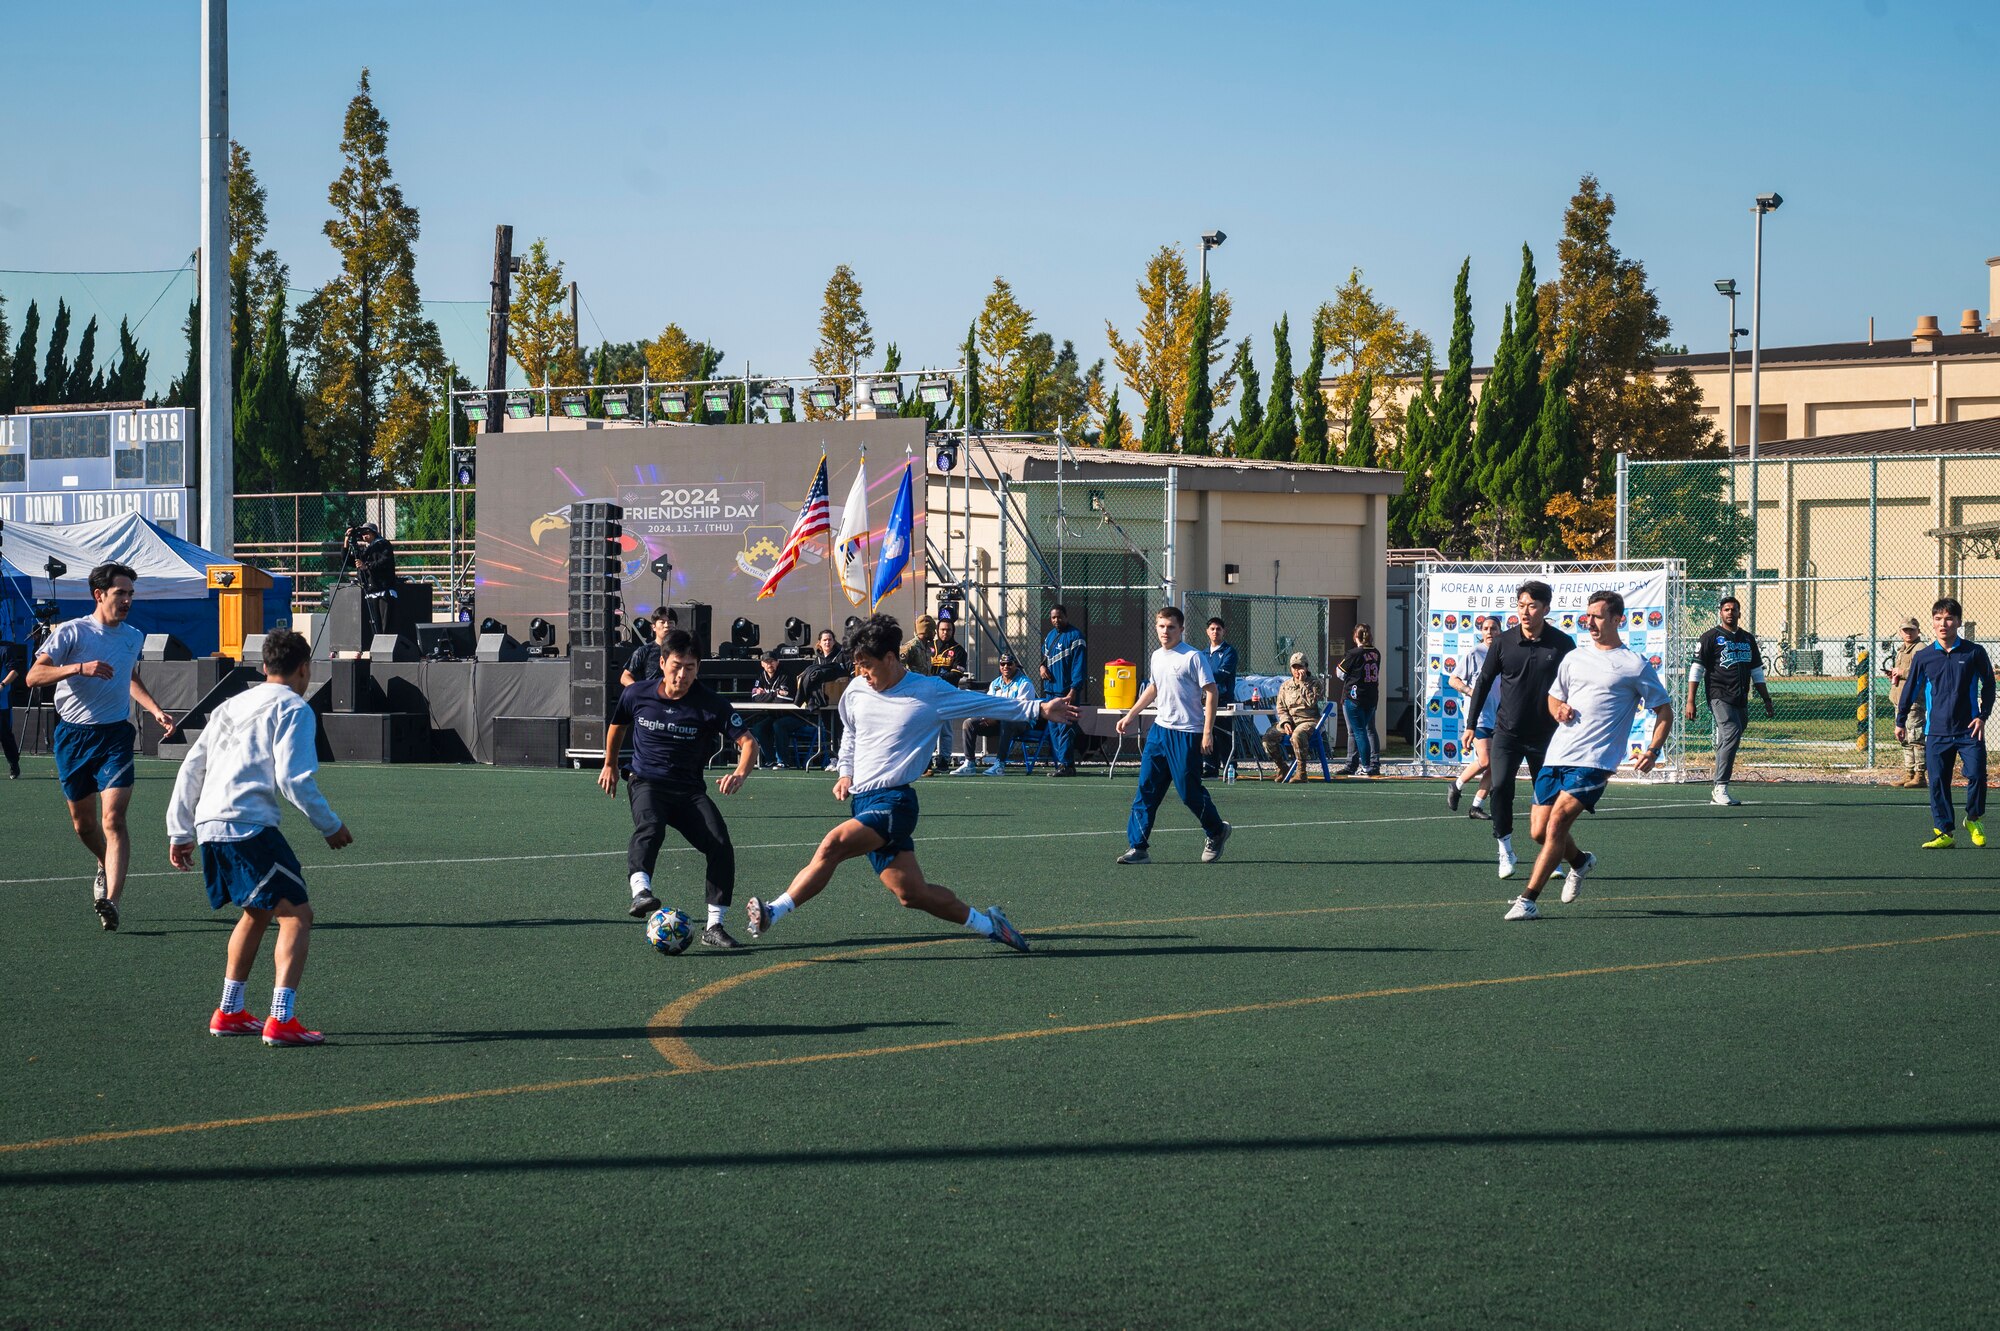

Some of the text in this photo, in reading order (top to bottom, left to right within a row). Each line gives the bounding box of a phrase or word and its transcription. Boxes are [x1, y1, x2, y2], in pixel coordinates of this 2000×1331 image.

[118, 413, 179, 442] GUESTS
[660, 488, 720, 506] 2024
[25, 495, 64, 522] DOWN
[79, 495, 104, 521] YDS
[106, 494, 122, 517] TO
[623, 504, 760, 520] FRIENDSHIP DAY
[648, 523, 734, 533] 2024. 11. 7. (THU)
[1441, 582, 1483, 594] KOREAN
[1486, 583, 1494, 594] &
[1497, 583, 1556, 594] AMEN
[1559, 581, 1625, 593] FRIENDSHIP
[1364, 663, 1378, 683] 13
[638, 716, 698, 735] Eagle Group
